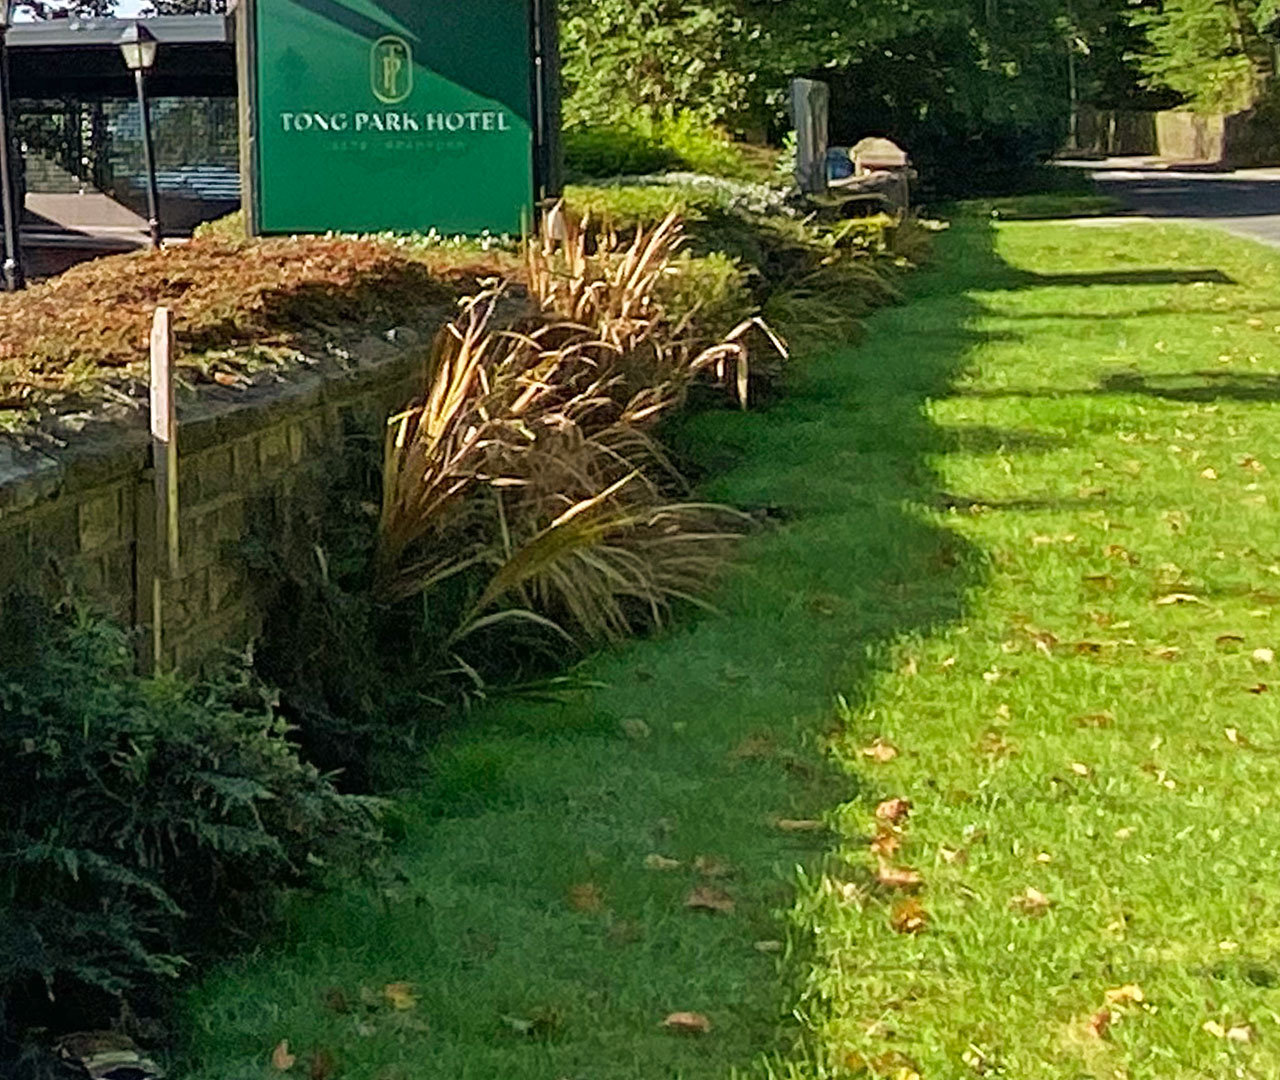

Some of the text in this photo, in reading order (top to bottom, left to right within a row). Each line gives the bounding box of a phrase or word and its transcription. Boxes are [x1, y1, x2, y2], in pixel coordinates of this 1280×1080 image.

[280, 111, 510, 132] TONG PARK HOTEL
